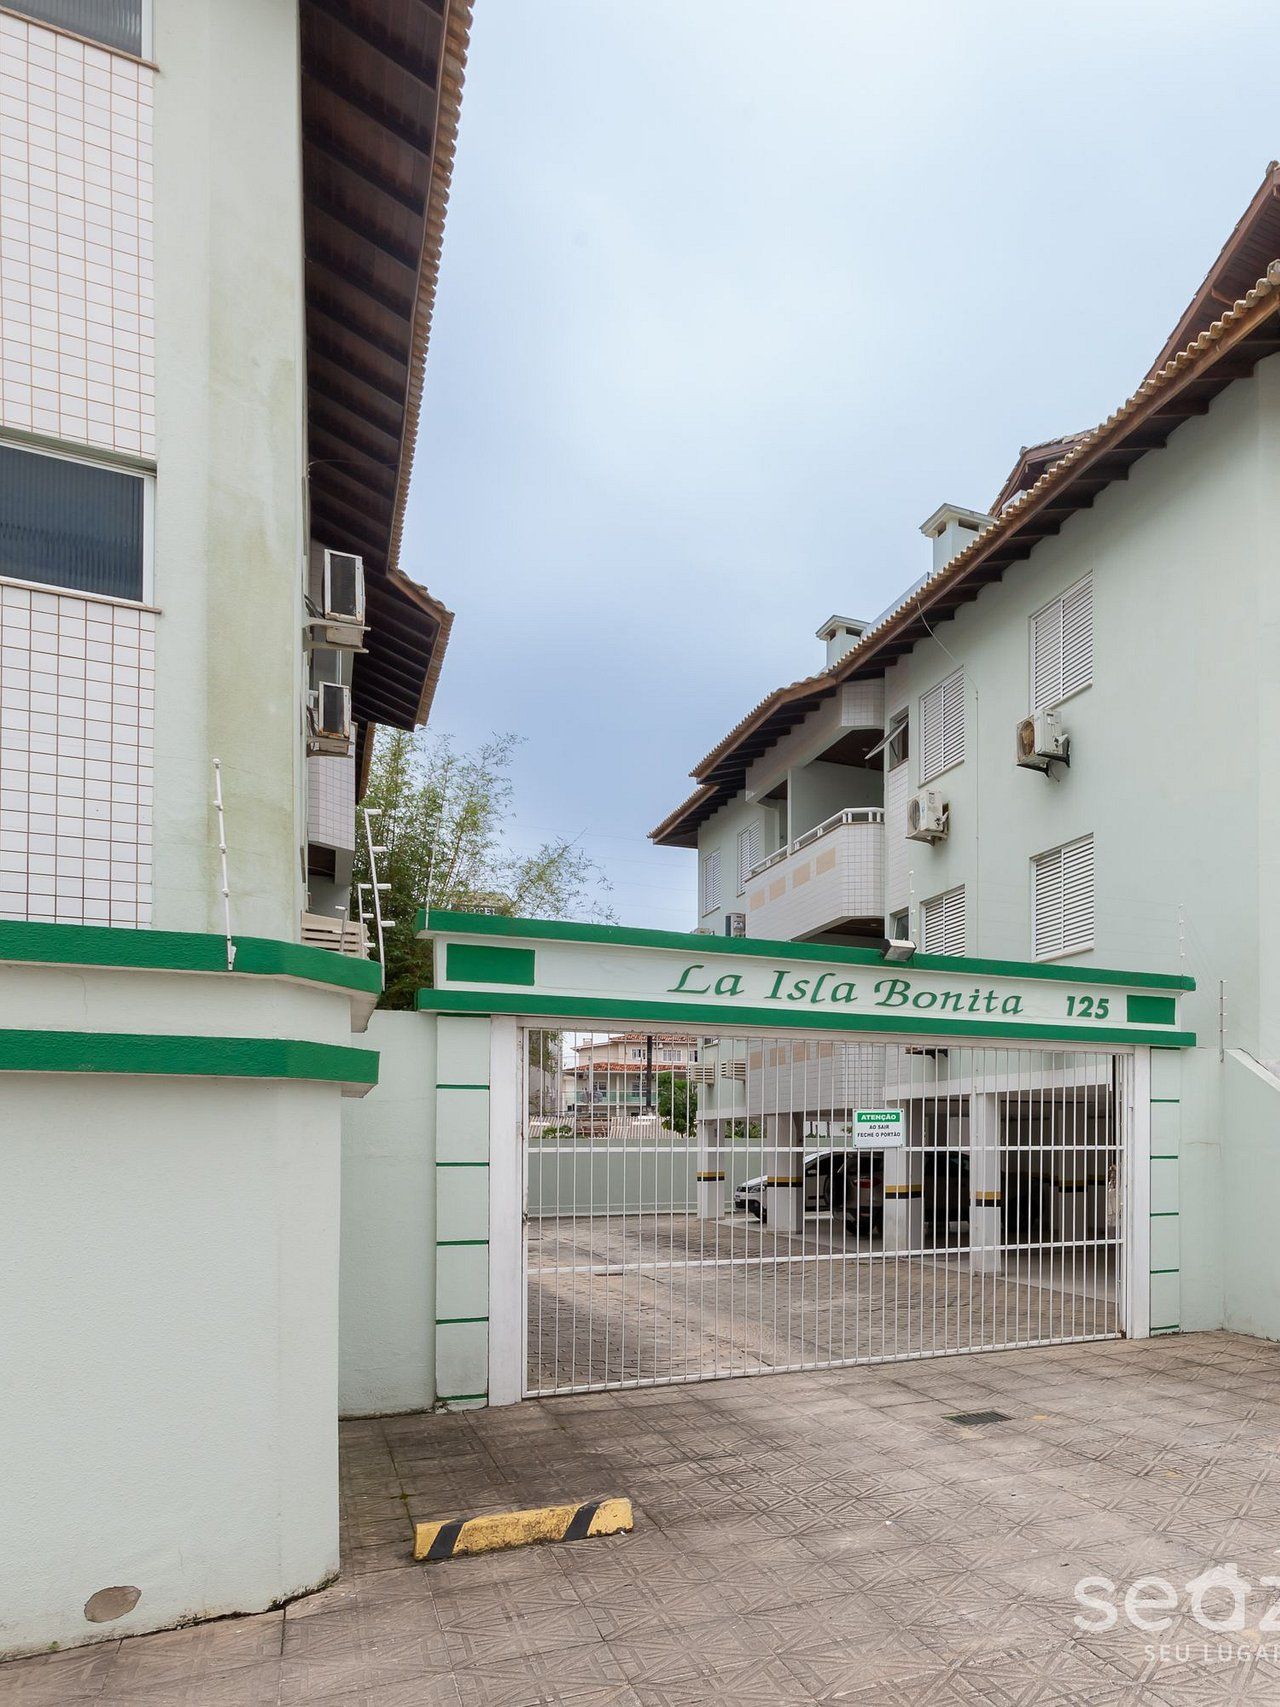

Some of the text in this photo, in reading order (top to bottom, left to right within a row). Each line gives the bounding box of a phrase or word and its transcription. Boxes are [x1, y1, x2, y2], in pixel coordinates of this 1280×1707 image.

[667, 964, 1110, 1019] La Isla Bonita 125
